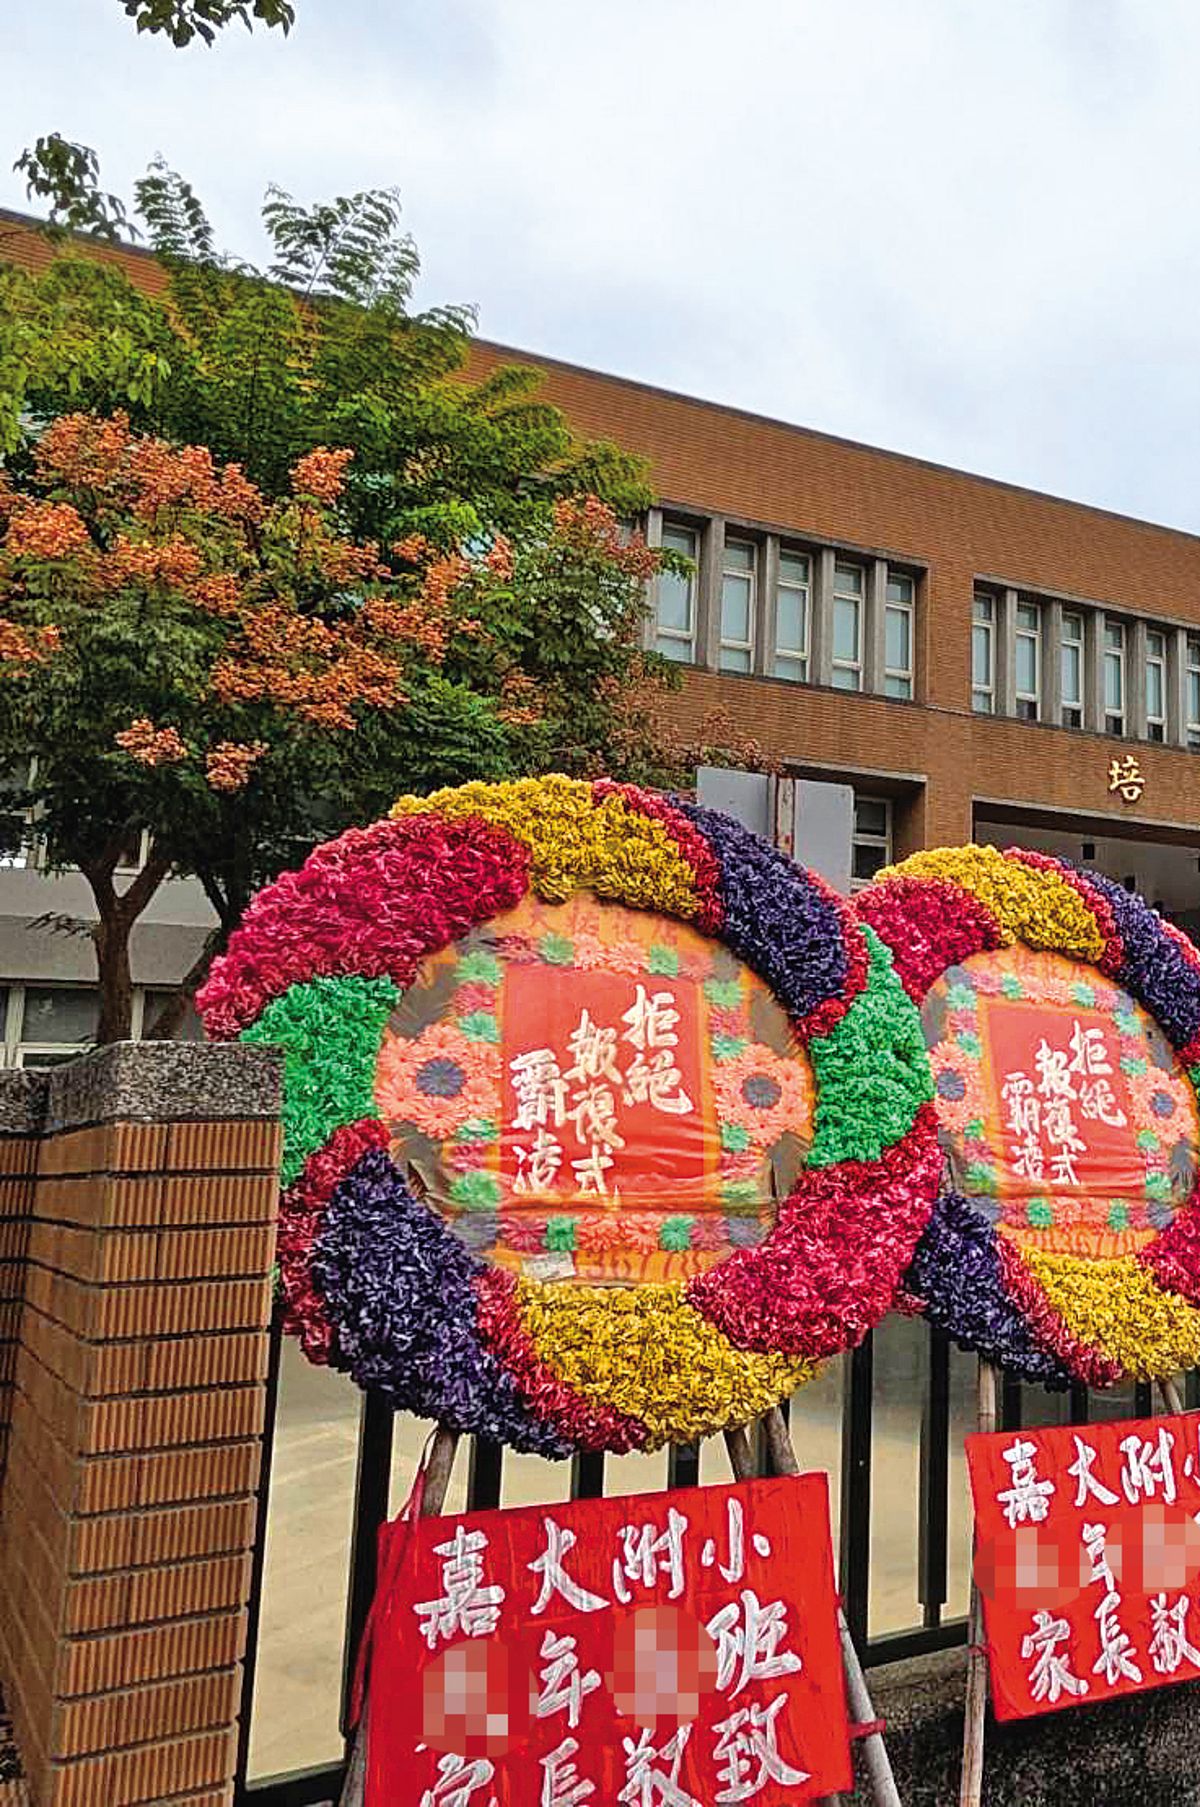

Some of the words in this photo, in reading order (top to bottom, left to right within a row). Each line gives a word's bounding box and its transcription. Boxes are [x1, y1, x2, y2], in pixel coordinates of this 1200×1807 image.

[563, 1008, 625, 1202] 報復式
[622, 984, 693, 1114] 拒絕
[1035, 1038, 1087, 1186] 報復式
[1069, 1019, 1127, 1128] 拒絕
[413, 1497, 771, 1647] 嘉大附小
